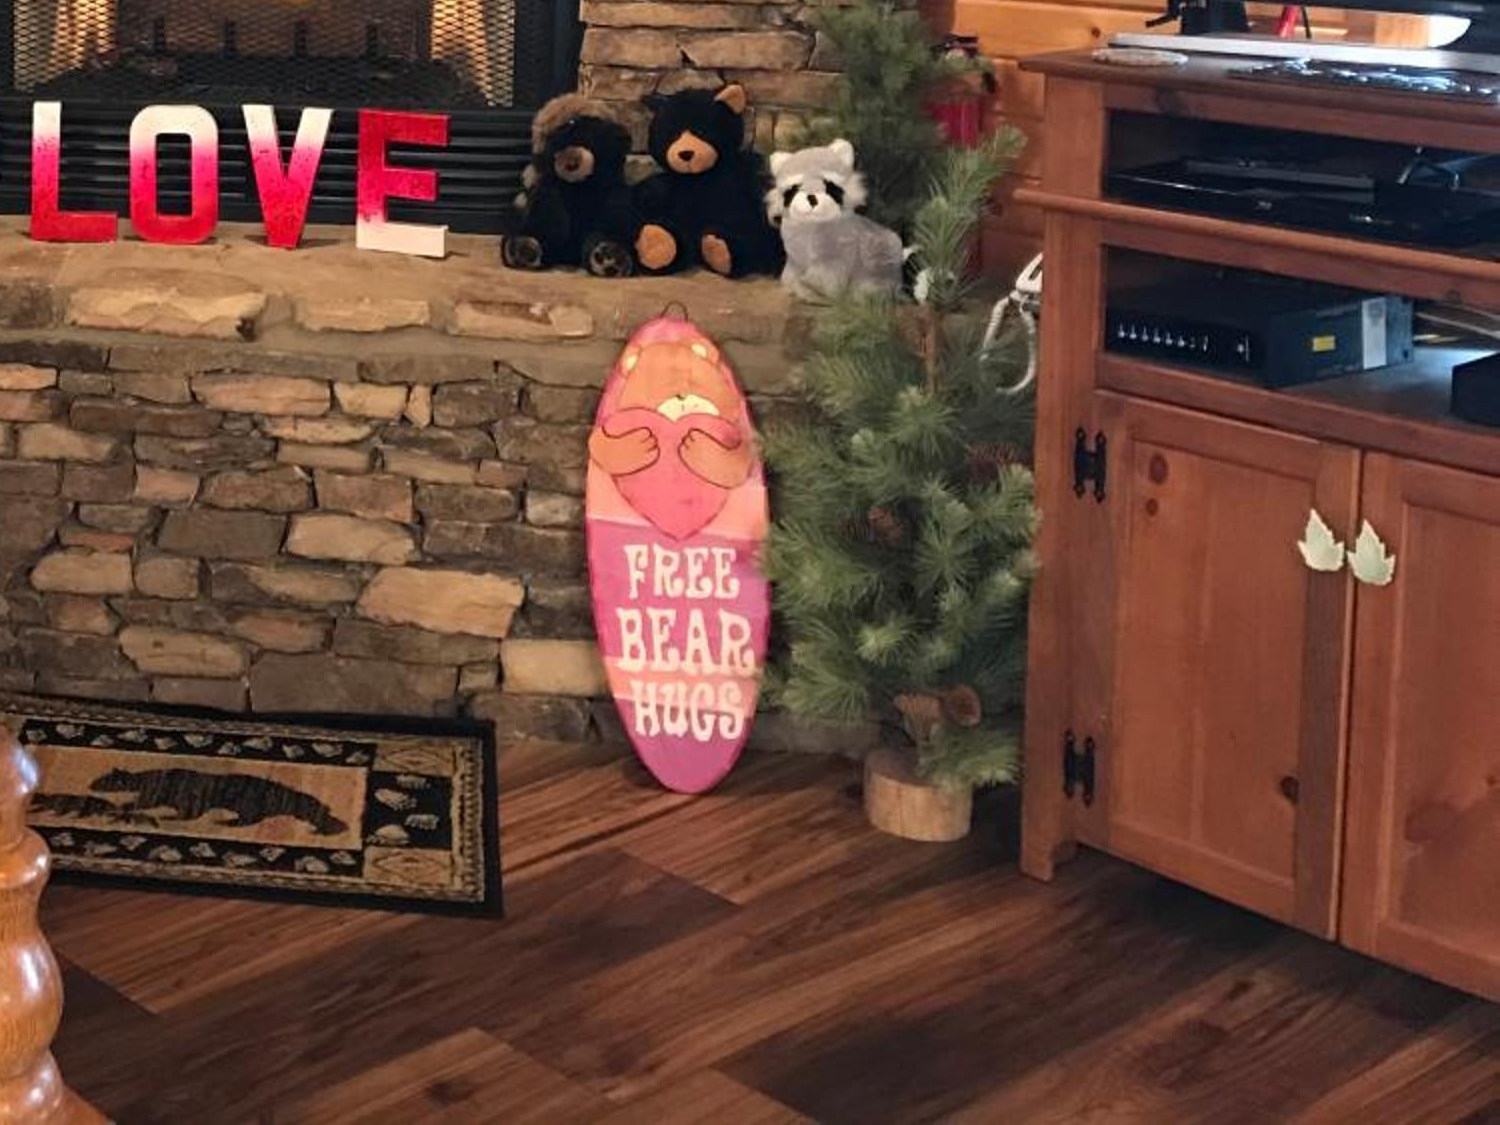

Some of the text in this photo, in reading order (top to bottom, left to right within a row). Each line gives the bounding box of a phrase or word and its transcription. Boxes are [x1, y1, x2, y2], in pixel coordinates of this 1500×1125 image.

[30, 101, 451, 258] LOVE
[624, 544, 740, 600] FREE
[615, 608, 761, 676] BEAR
[632, 680, 745, 742] HUGS
